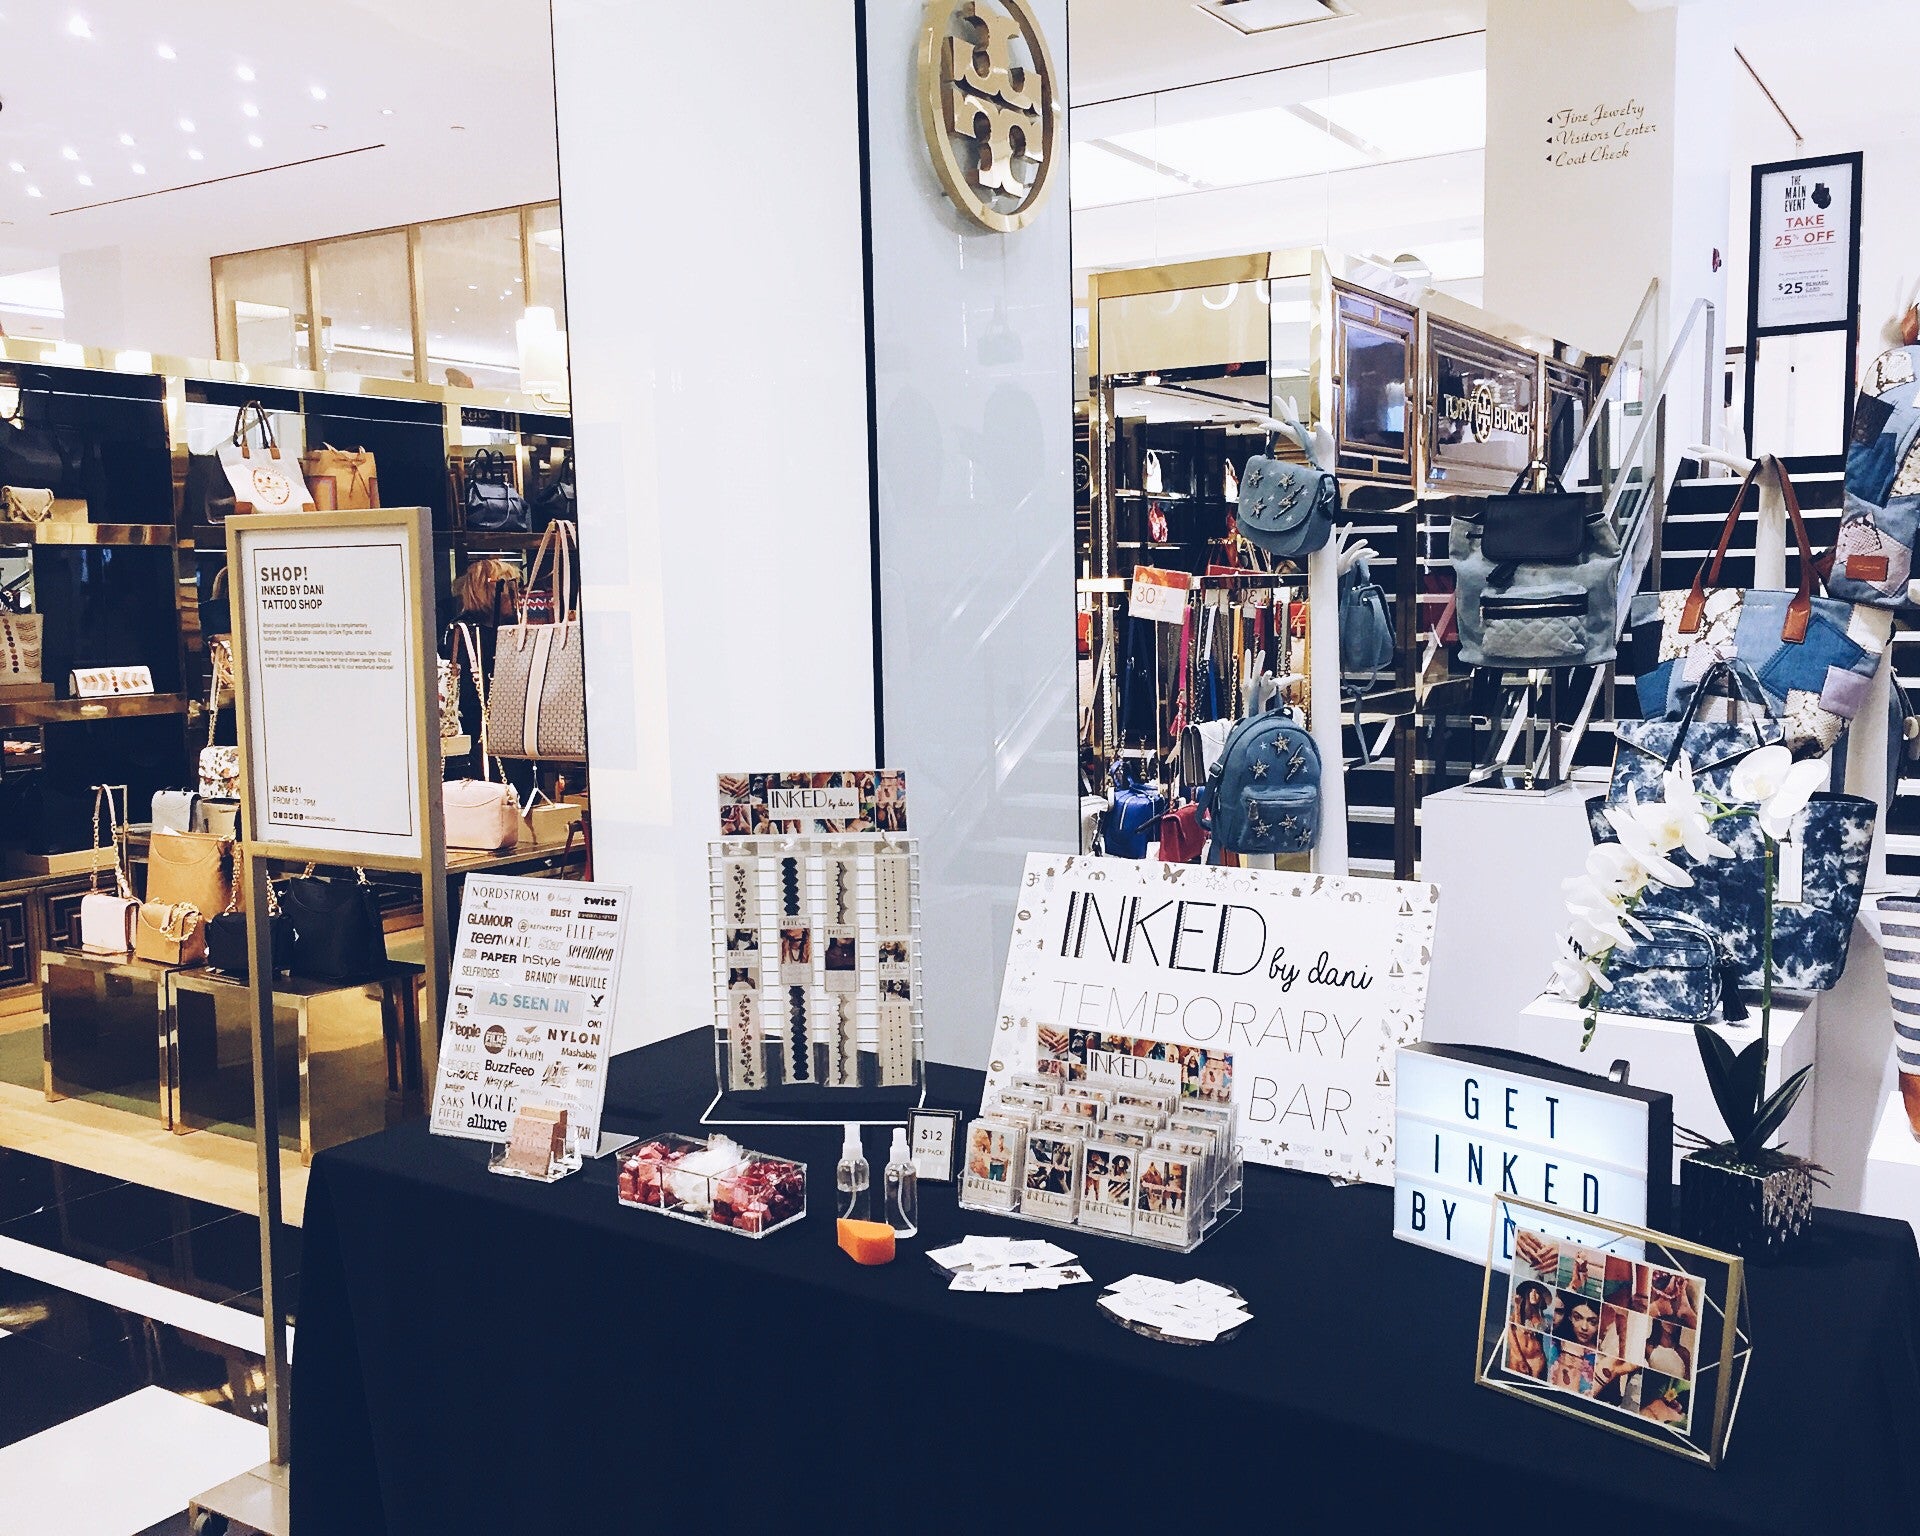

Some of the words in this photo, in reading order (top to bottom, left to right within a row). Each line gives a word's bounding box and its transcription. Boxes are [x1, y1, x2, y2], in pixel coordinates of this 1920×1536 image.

[1556, 108, 1589, 128] Fine
[1590, 99, 1644, 127] Jewelry
[1556, 130, 1609, 145] Visitors
[1614, 122, 1656, 138] Center
[1556, 151, 1586, 166] Coat
[1591, 142, 1629, 161] Check
[1791, 175, 1801, 186] THE
[1785, 185, 1806, 199] MAIN
[1784, 198, 1806, 212] EVENT
[1786, 214, 1824, 228] TAKE
[1804, 230, 1835, 243] OFF
[1778, 282, 1803, 295] $25
[1443, 394, 1475, 422] TORY
[1494, 406, 1530, 435] BURCH
[261, 566, 308, 582] SHOP!
[261, 585, 288, 596] INKED
[290, 585, 300, 595] BY
[303, 585, 324, 595] DANI
[262, 599, 297, 610] TATTOO
[299, 599, 323, 610] SHOP
[771, 790, 827, 808] INKED
[828, 800, 836, 810] by
[473, 886, 539, 901] NORDSTROM
[583, 896, 617, 907] twist
[550, 909, 571, 918] BUST
[468, 913, 513, 928] GLAMOUR
[567, 924, 595, 940] ELLE
[1060, 890, 1267, 976] INKED
[1268, 947, 1300, 992] by
[1307, 951, 1373, 991] dani
[480, 952, 517, 963] PAPER
[522, 954, 561, 967] InStyle
[566, 945, 614, 961] seventeen
[462, 966, 500, 979] SELFRIDGES
[525, 970, 558, 984] BRANDY
[569, 975, 608, 989] MELVILLE
[489, 992, 508, 1006] AS
[513, 994, 549, 1011] SEEN
[554, 999, 569, 1013] IN
[1053, 980, 1363, 1059] TEMPORARY
[450, 1021, 481, 1039] People
[587, 1020, 602, 1028] OK!
[547, 1029, 600, 1045] NYLON
[561, 1047, 597, 1060] Mashable
[1090, 1052, 1148, 1080] INKED
[1148, 1071, 1157, 1085] by
[1160, 1073, 1176, 1086] dani
[441, 1095, 464, 1109] SAKS
[471, 1092, 518, 1113] VOGUE
[1249, 1076, 1352, 1135] BAR
[1464, 1078, 1559, 1139] GET
[439, 1108, 463, 1119] FIFTH
[467, 1113, 507, 1132] allure
[922, 1129, 943, 1141] $12
[1434, 1134, 1600, 1214] INKED
[1411, 1190, 1457, 1241] BY
